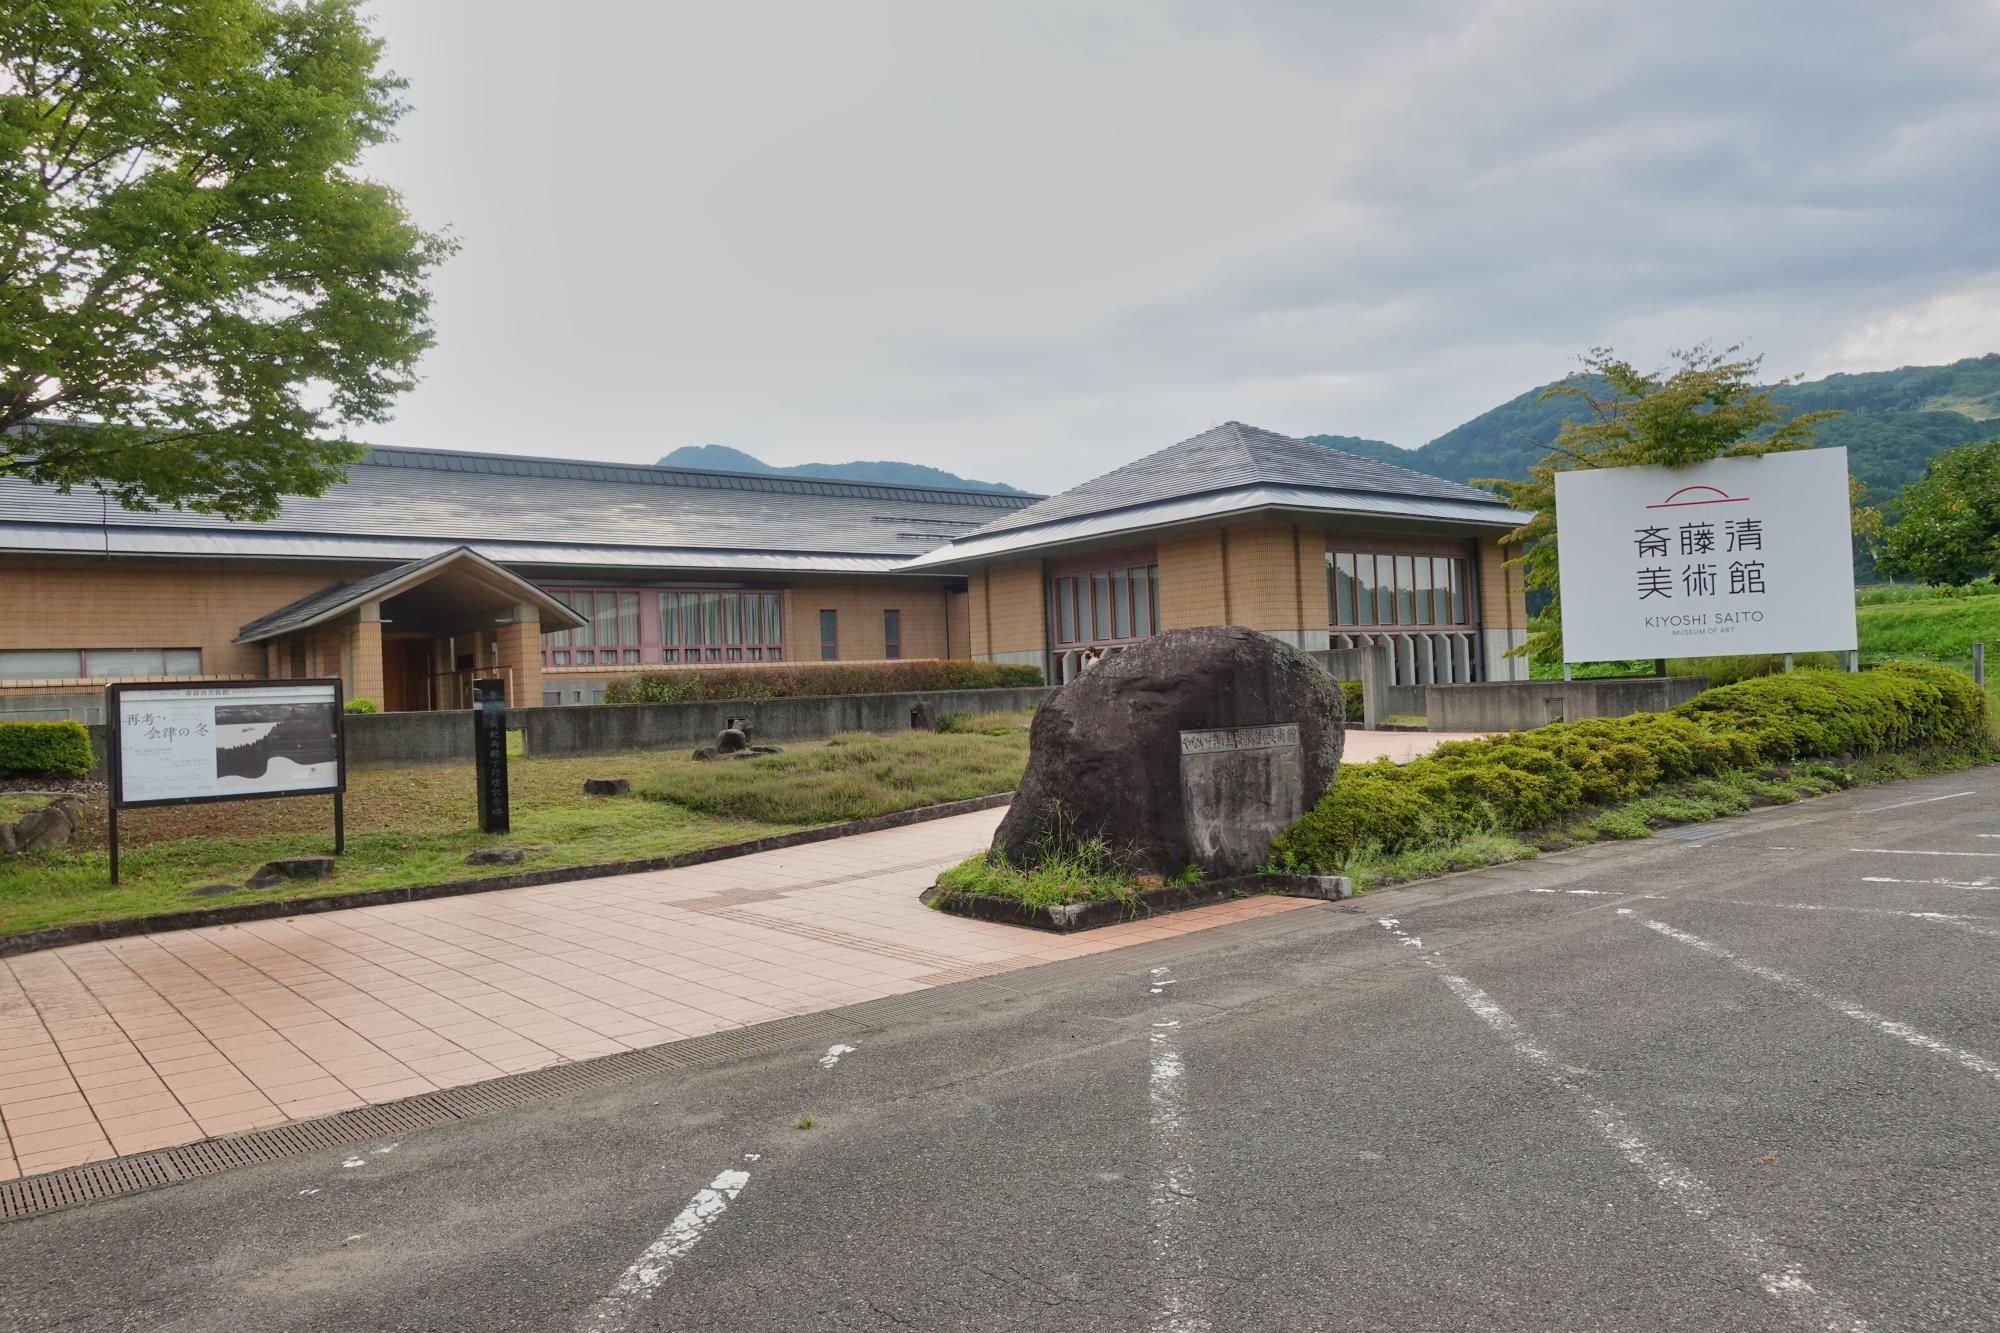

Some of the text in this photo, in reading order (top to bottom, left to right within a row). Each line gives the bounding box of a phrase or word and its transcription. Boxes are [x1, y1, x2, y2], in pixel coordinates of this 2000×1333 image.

[1633, 517, 1763, 559] 斎藤清
[1637, 559, 1766, 600] 美術館
[1645, 610, 1764, 628] KIYOSHI SAITO
[1672, 626, 1735, 636] MUSEUM OF ART
[143, 722, 210, 743] 会津の冬
